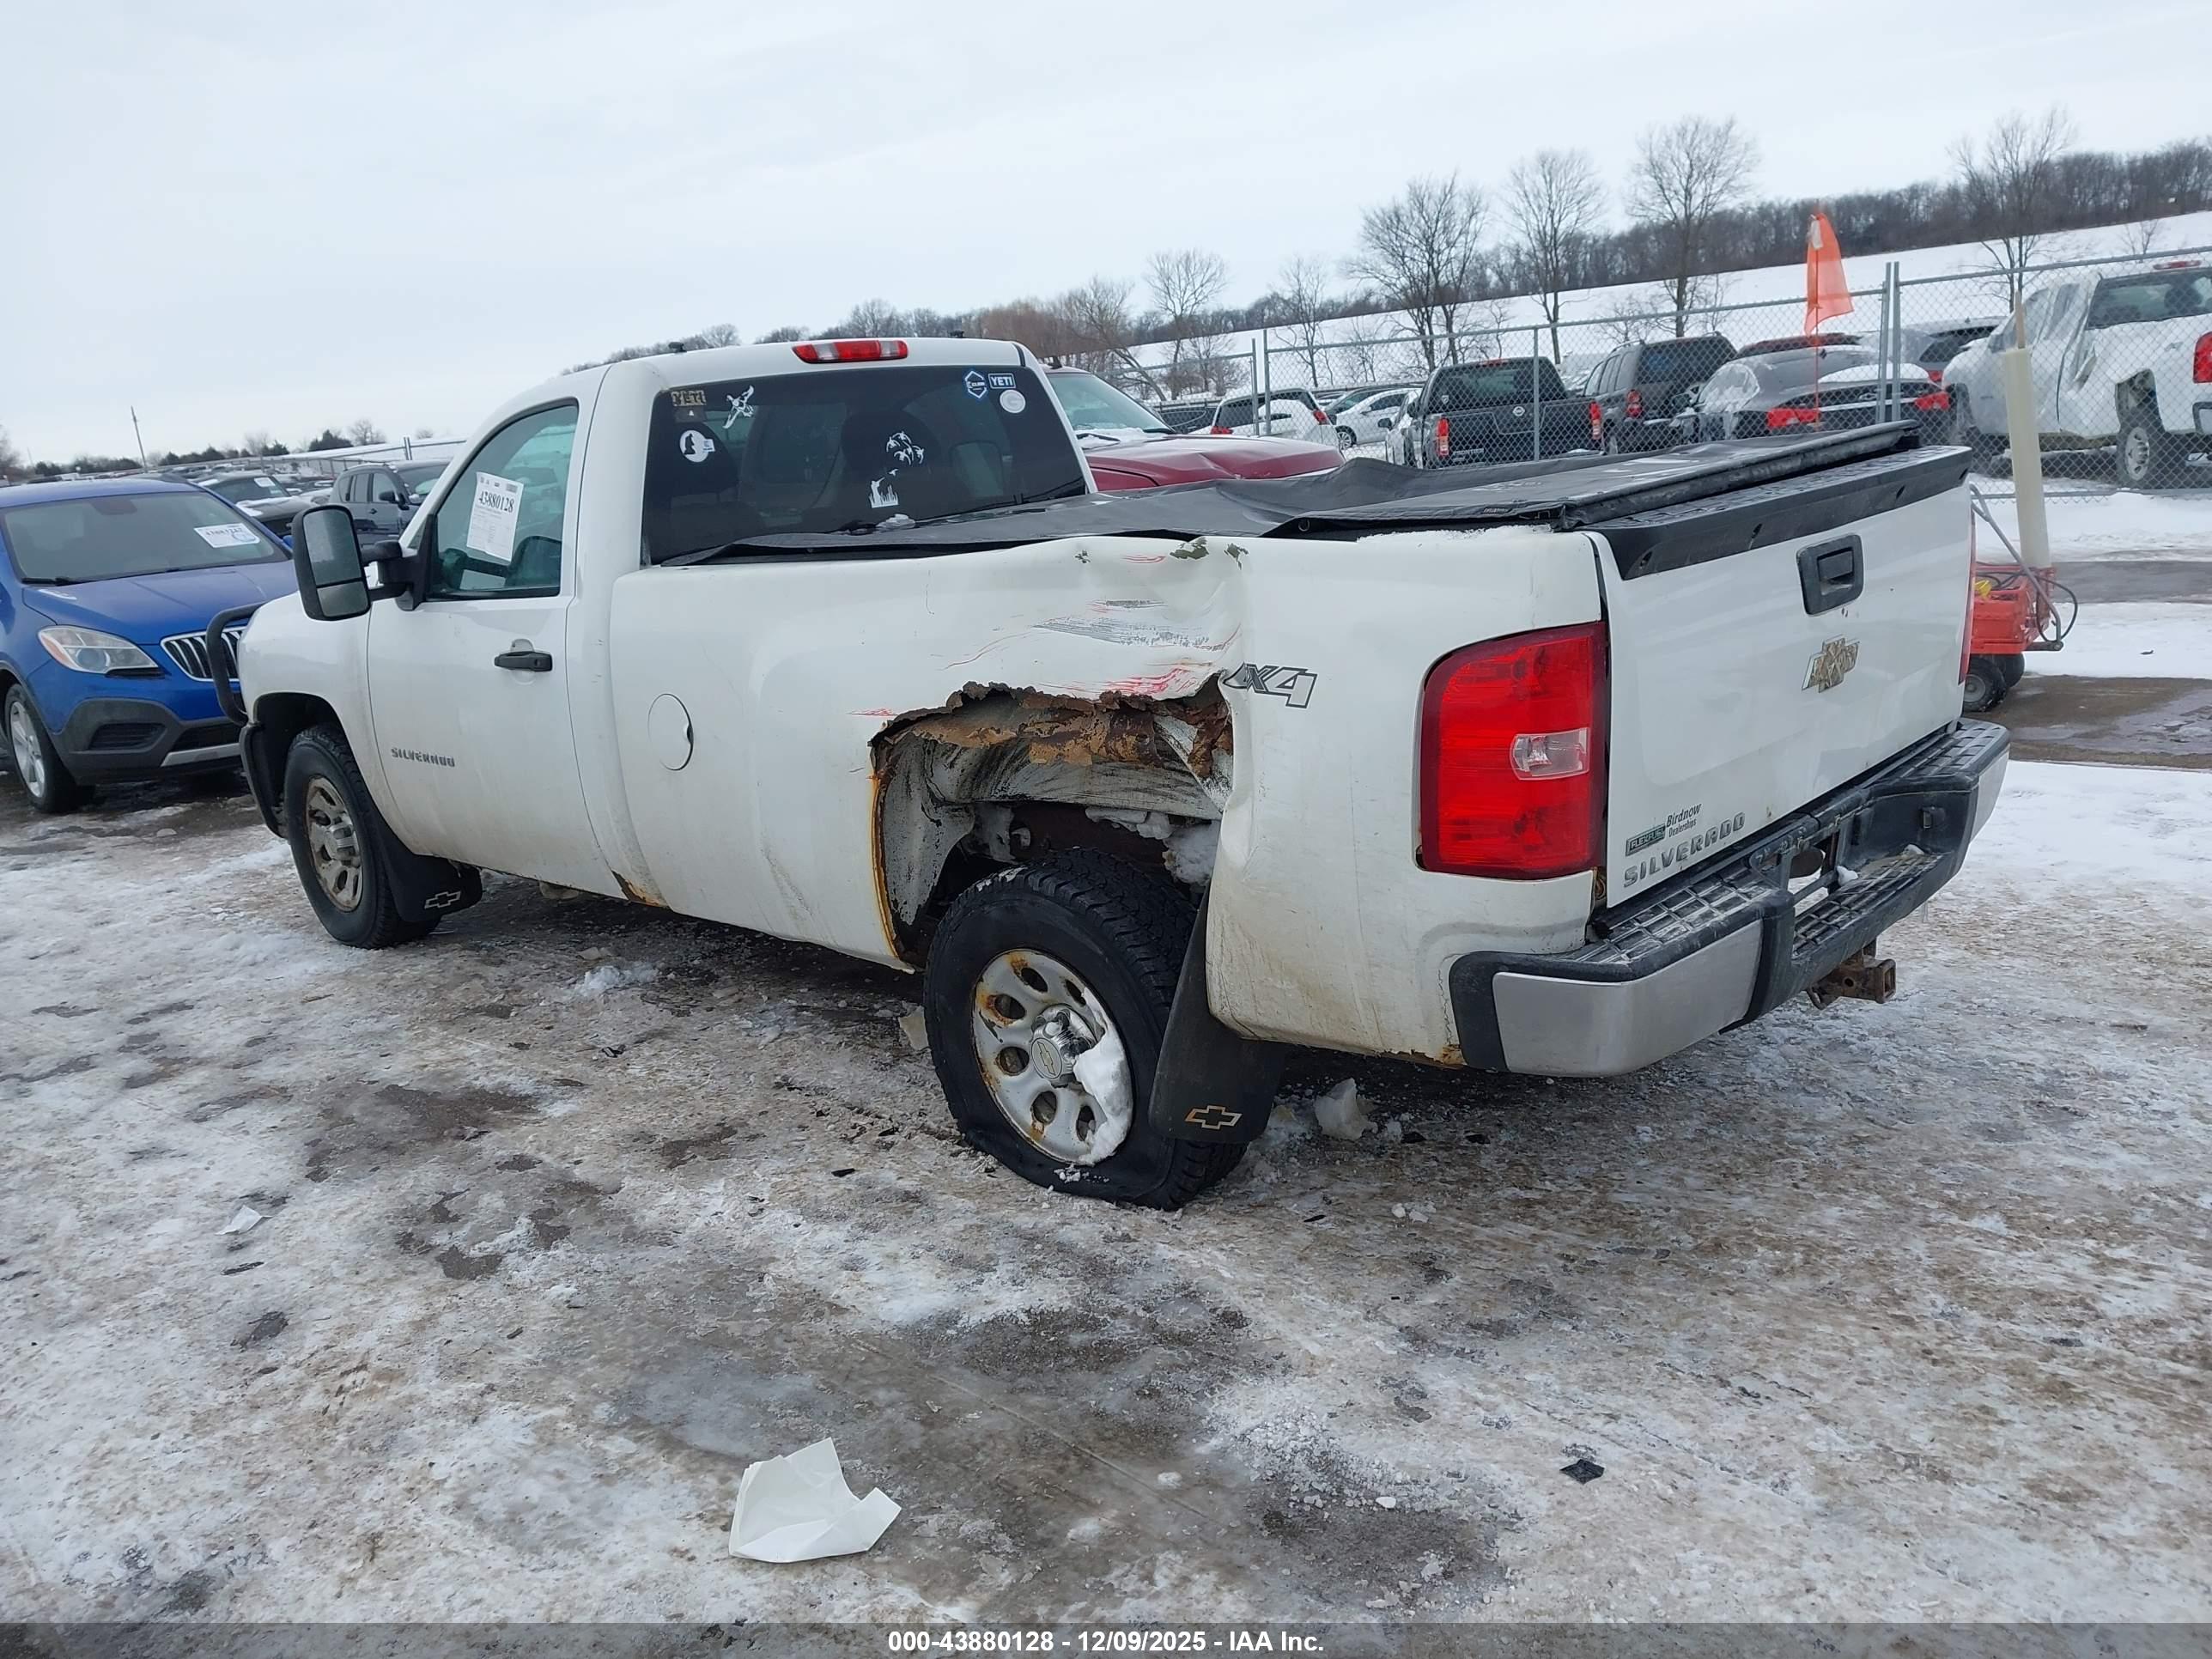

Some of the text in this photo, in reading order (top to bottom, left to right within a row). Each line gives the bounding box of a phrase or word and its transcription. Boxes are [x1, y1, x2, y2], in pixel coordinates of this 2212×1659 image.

[990, 376, 1013, 386] YETI
[478, 491, 515, 514] 43880128
[1666, 804, 1702, 828] Birdnow
[1668, 818, 1697, 837] Dealerships
[1624, 811, 1746, 888] SILVERADO
